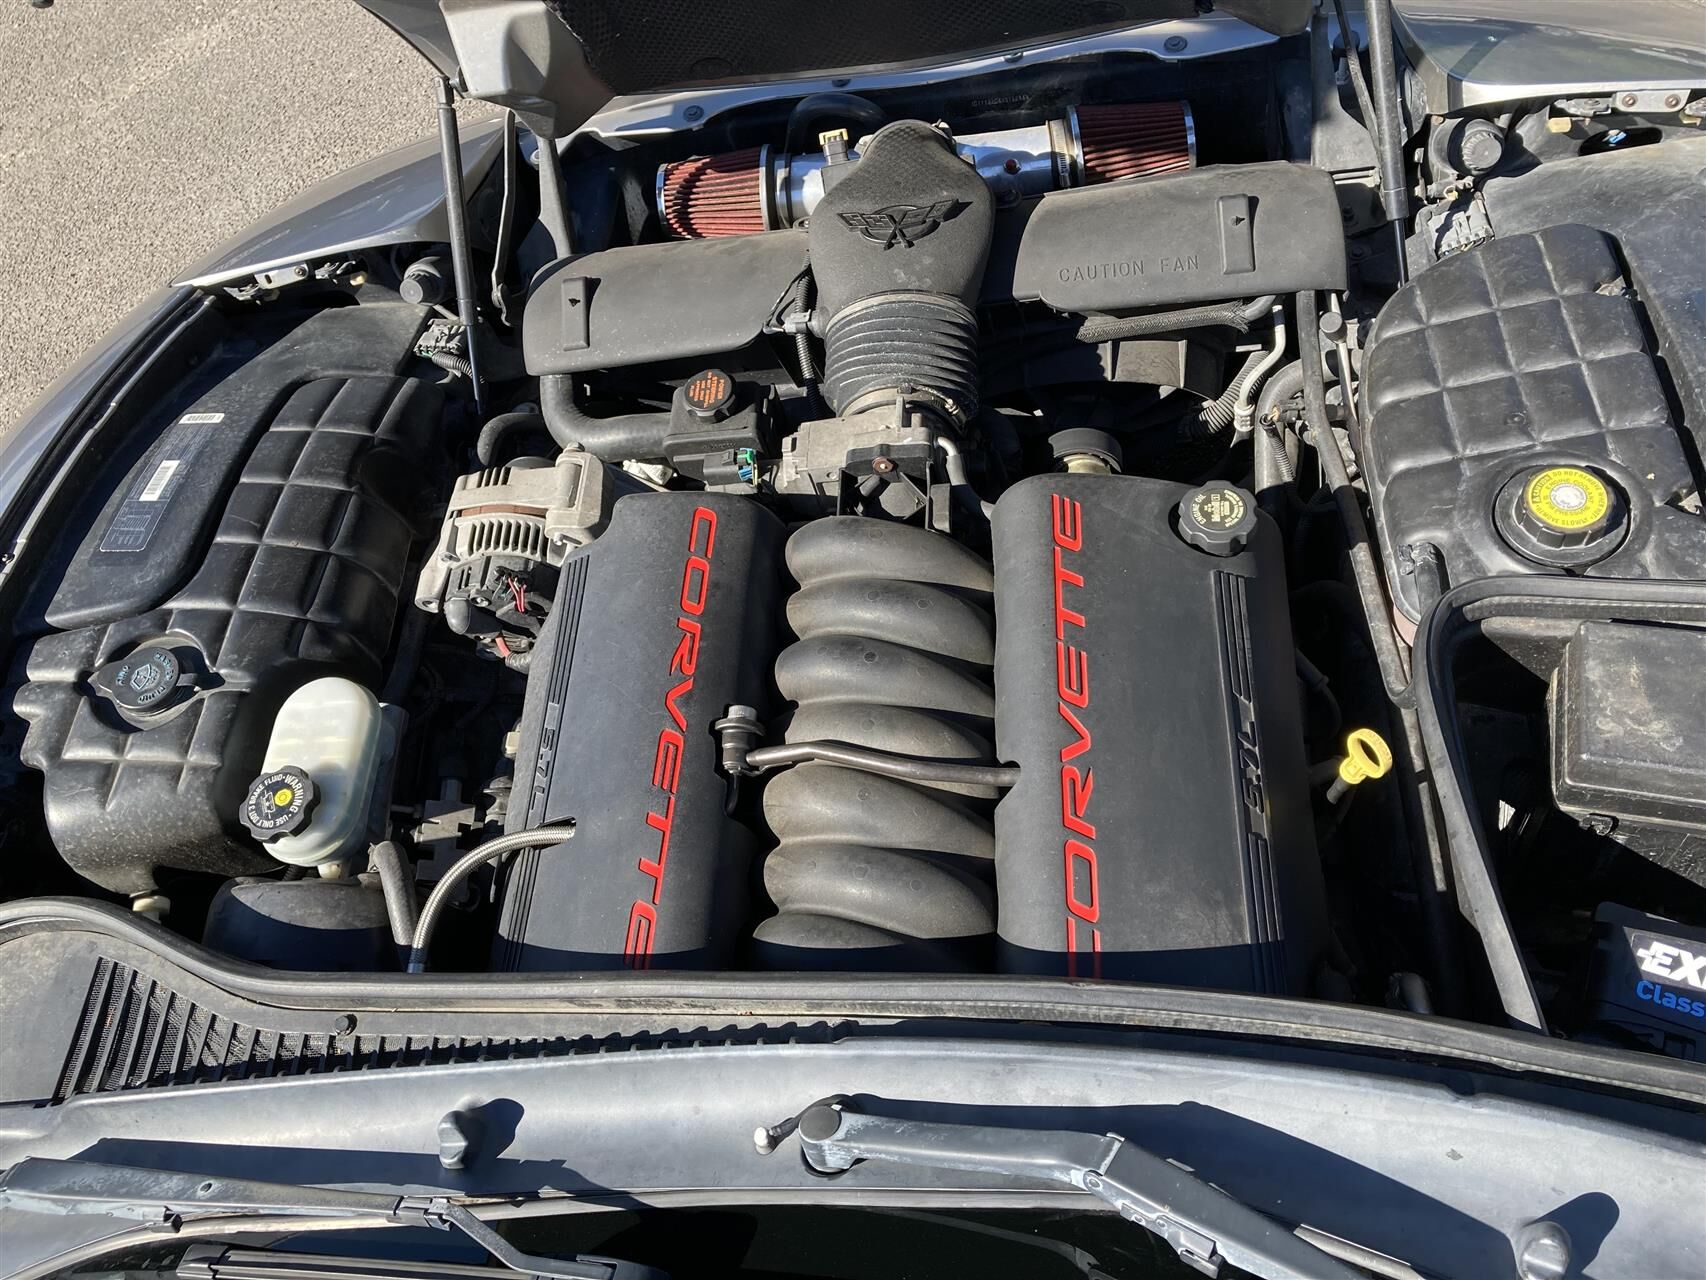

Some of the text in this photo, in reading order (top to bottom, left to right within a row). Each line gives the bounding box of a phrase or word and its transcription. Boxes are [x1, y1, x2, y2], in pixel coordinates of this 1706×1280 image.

[1058, 254, 1200, 283] CAUTION FAN
[1194, 493, 1207, 503] OIL
[1192, 503, 1207, 525] ENGINE
[624, 506, 718, 970] CORVETTE
[264, 773, 283, 786] FLUID
[531, 727, 556, 811] 5.7L
[1237, 720, 1265, 814] 5.7L
[250, 784, 265, 804] BRAKE
[284, 774, 304, 813] WARNING
[257, 820, 274, 828] ONLY
[276, 815, 289, 826] USE
[1636, 941, 1706, 990] EX
